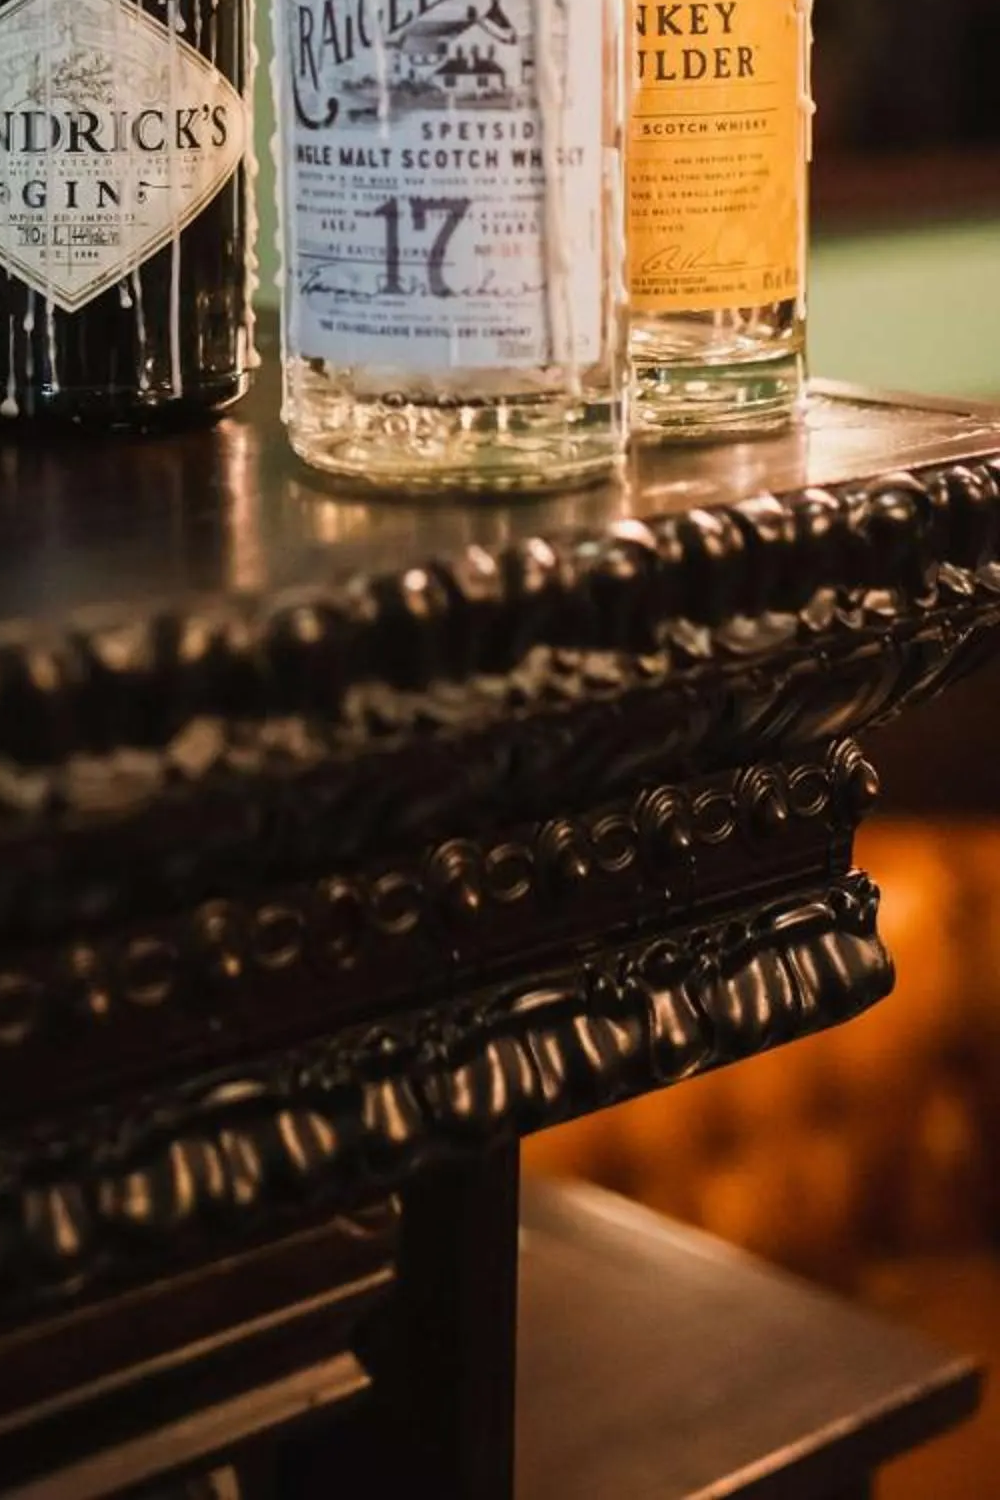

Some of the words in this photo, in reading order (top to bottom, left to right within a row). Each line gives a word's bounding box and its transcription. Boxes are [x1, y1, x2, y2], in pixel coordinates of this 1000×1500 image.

[421, 121, 538, 142] SPEYSID
[642, 122, 708, 136] SCOTCH
[339, 146, 391, 169] MALT
[401, 148, 499, 170] SCOTCH
[21, 180, 122, 209] GIN
[374, 197, 474, 298] 17
